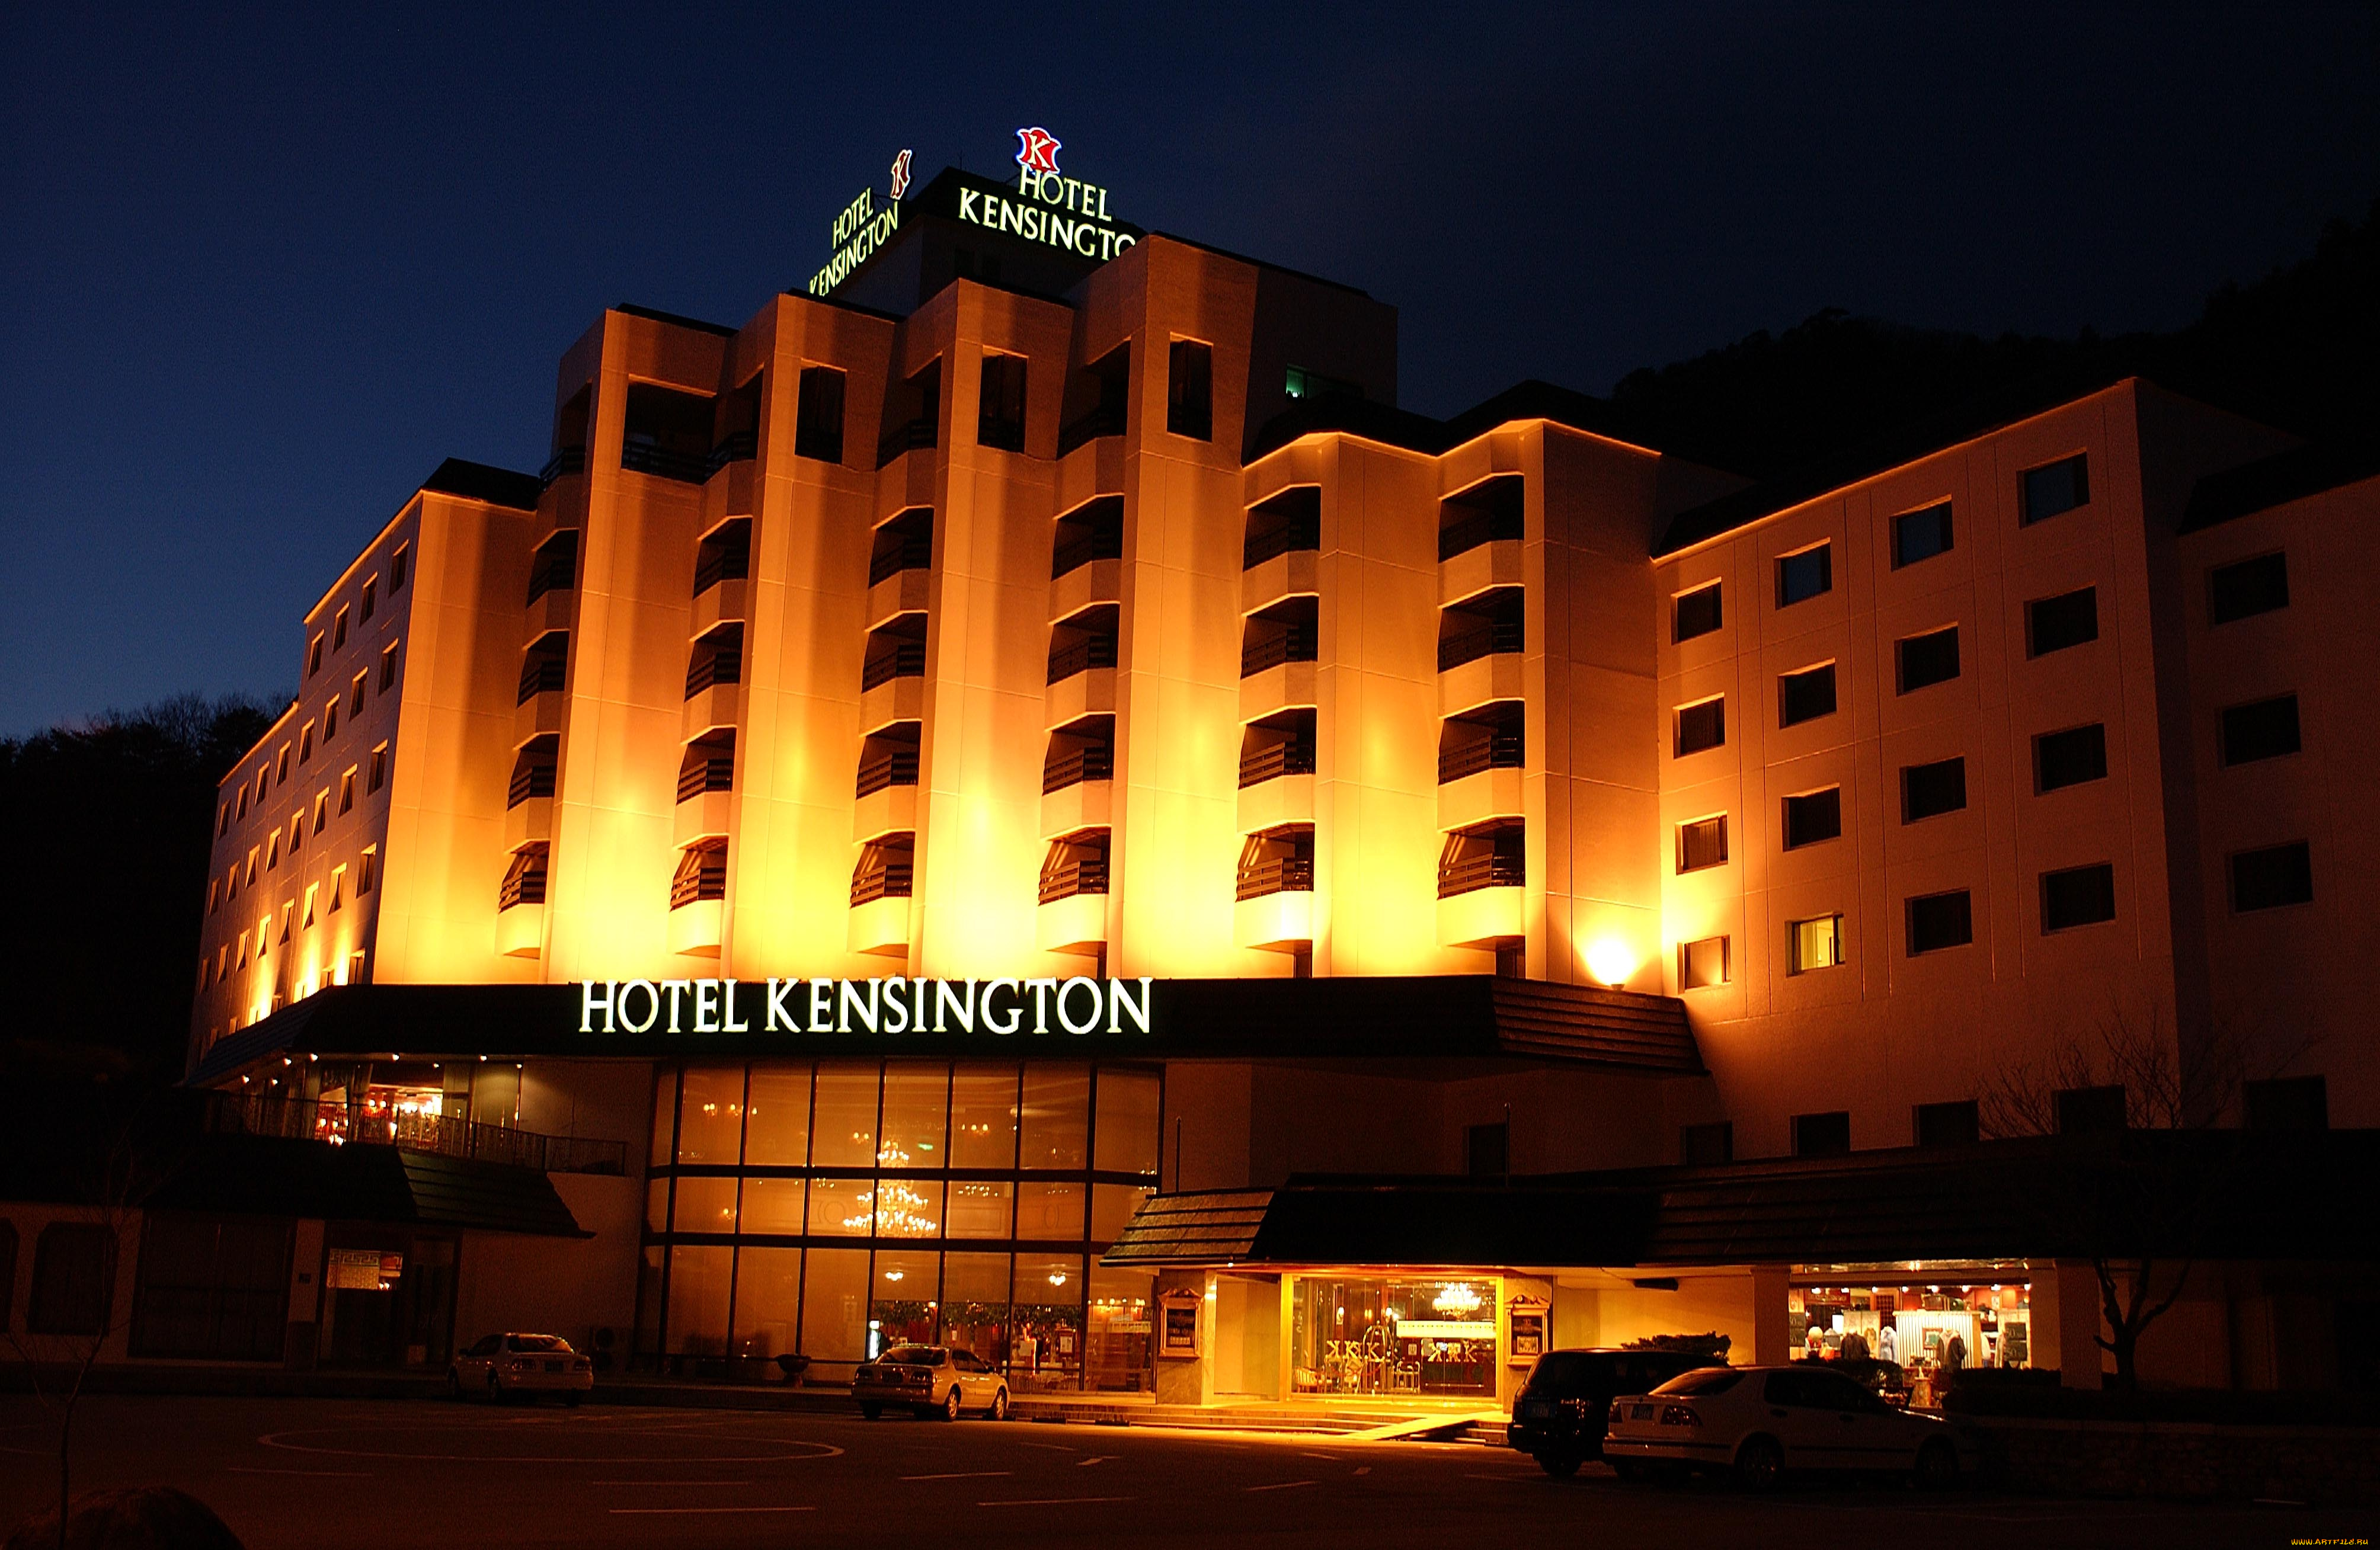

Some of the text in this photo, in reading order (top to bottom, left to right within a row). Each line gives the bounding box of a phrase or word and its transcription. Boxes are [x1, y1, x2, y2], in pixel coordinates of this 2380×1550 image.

[1028, 133, 1052, 168] K
[833, 187, 874, 250] HOTEL
[1019, 164, 1112, 223] HOTEL
[578, 976, 1153, 1035] HOTEL KENSINGTON
